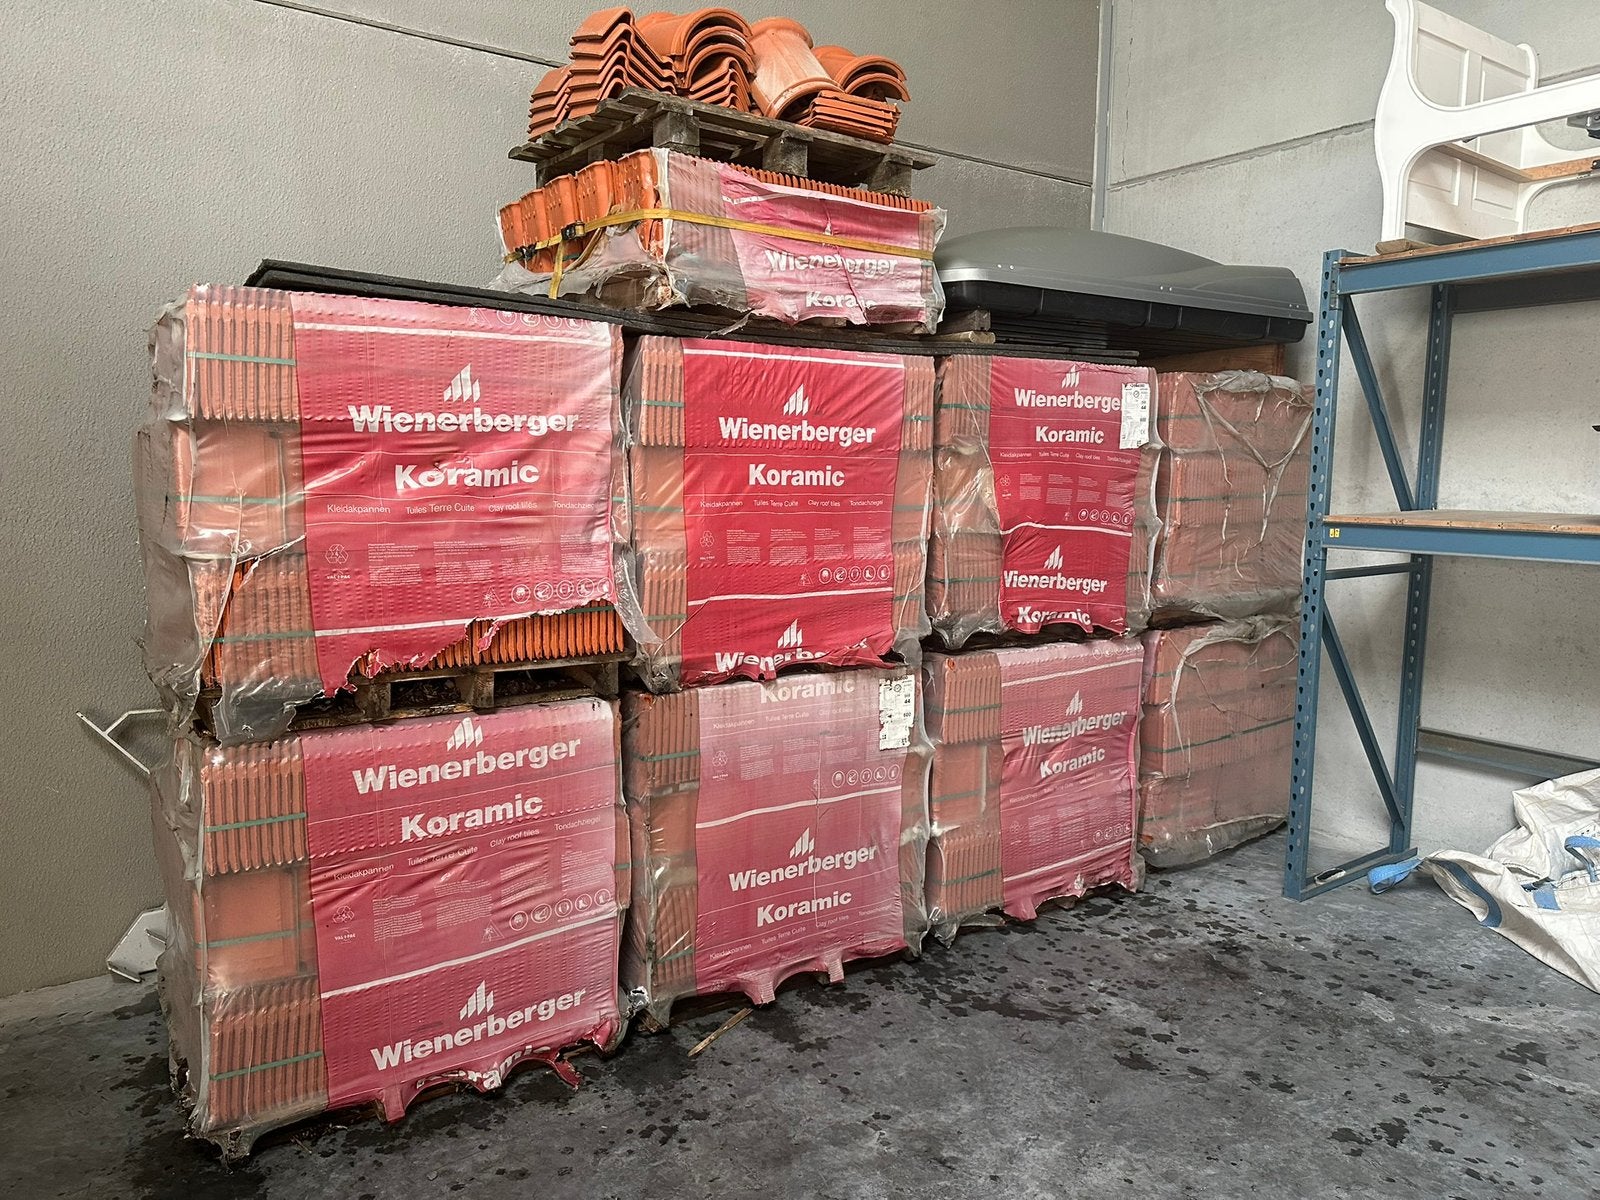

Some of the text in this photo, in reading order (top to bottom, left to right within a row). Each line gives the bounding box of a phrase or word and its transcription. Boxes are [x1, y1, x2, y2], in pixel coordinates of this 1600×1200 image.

[765, 250, 898, 278] Wieneerger
[806, 291, 877, 309] Kora
[1014, 387, 1121, 413] Wienerberge
[348, 405, 579, 436] Wienerberger
[718, 416, 877, 447] Wienerberger
[1035, 426, 1105, 444] Koramic
[395, 460, 540, 492] Koramic
[749, 463, 845, 487] Koramic
[327, 504, 391, 514] Kleidakpannen
[406, 506, 427, 515] Tuiles
[428, 503, 452, 513] Terre
[454, 502, 475, 512] Cuite
[1017, 606, 1091, 625] Koramic
[760, 677, 855, 704] Koramic
[1022, 710, 1128, 748] Wienerberger
[352, 738, 581, 795] Wienerberger
[1040, 746, 1106, 778] Koramic
[400, 793, 544, 843] Koramic
[489, 837, 507, 849] Clay
[507, 832, 523, 842] roof
[729, 844, 877, 892] Wienerberger
[757, 890, 852, 928] Koramic
[370, 987, 587, 1072] Wienerberger
